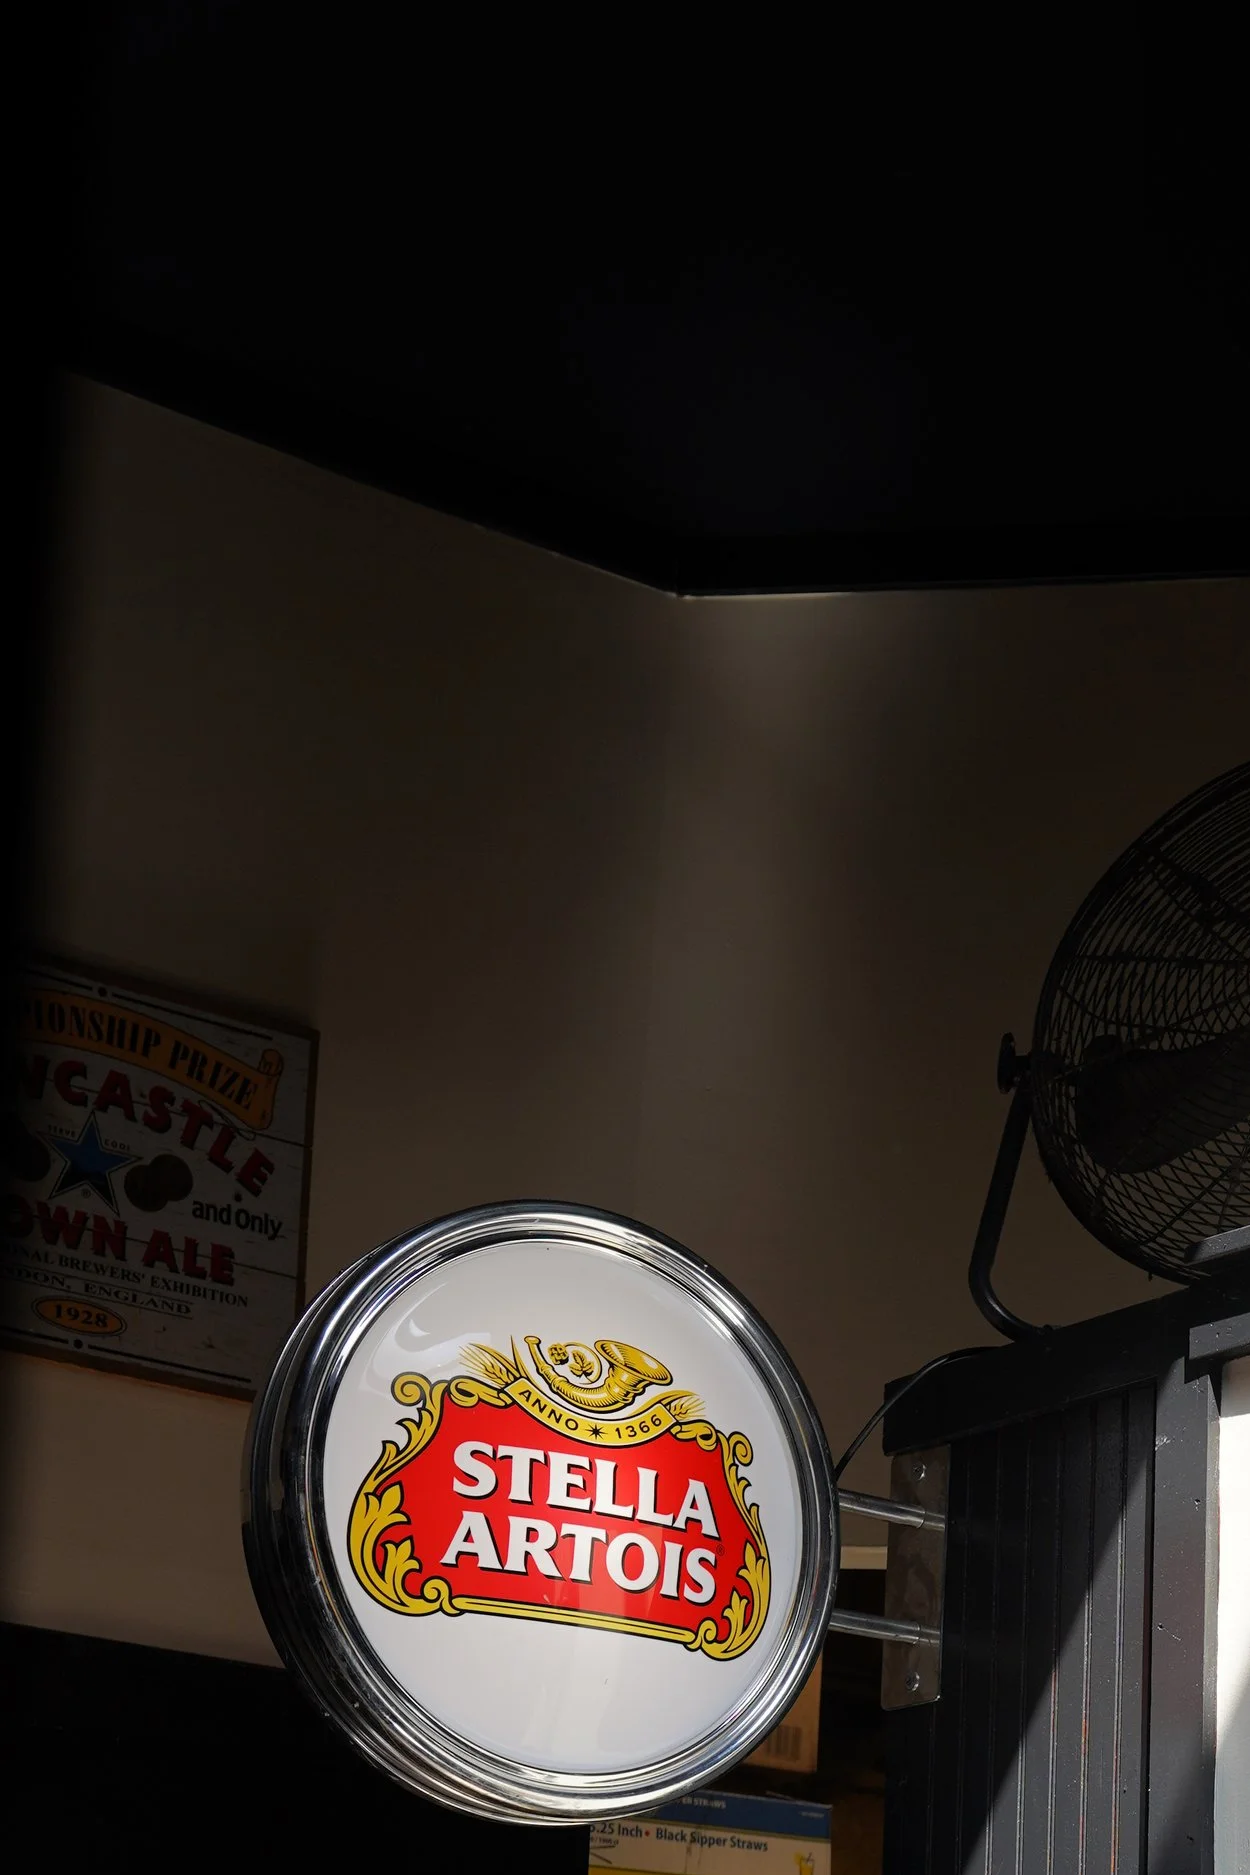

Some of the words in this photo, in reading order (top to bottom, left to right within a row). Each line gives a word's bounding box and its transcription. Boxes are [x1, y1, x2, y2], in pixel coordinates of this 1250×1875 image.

[168, 1038, 257, 1110] PRIZE
[192, 1197, 232, 1227] and
[235, 1207, 283, 1239] Only
[142, 1228, 236, 1287] ALE
[84, 1282, 192, 1315] ENGLAND
[151, 1275, 249, 1308] EXHIBITION
[55, 1304, 109, 1329] 1928
[518, 1388, 580, 1432] ANNO
[614, 1413, 663, 1440] 1366
[452, 1440, 722, 1539] STELLA
[440, 1510, 718, 1604] ARTOIS
[617, 1824, 643, 1838] Inch
[655, 1828, 687, 1843] Black
[690, 1831, 728, 1849] Sipper
[730, 1836, 769, 1851] Straws
